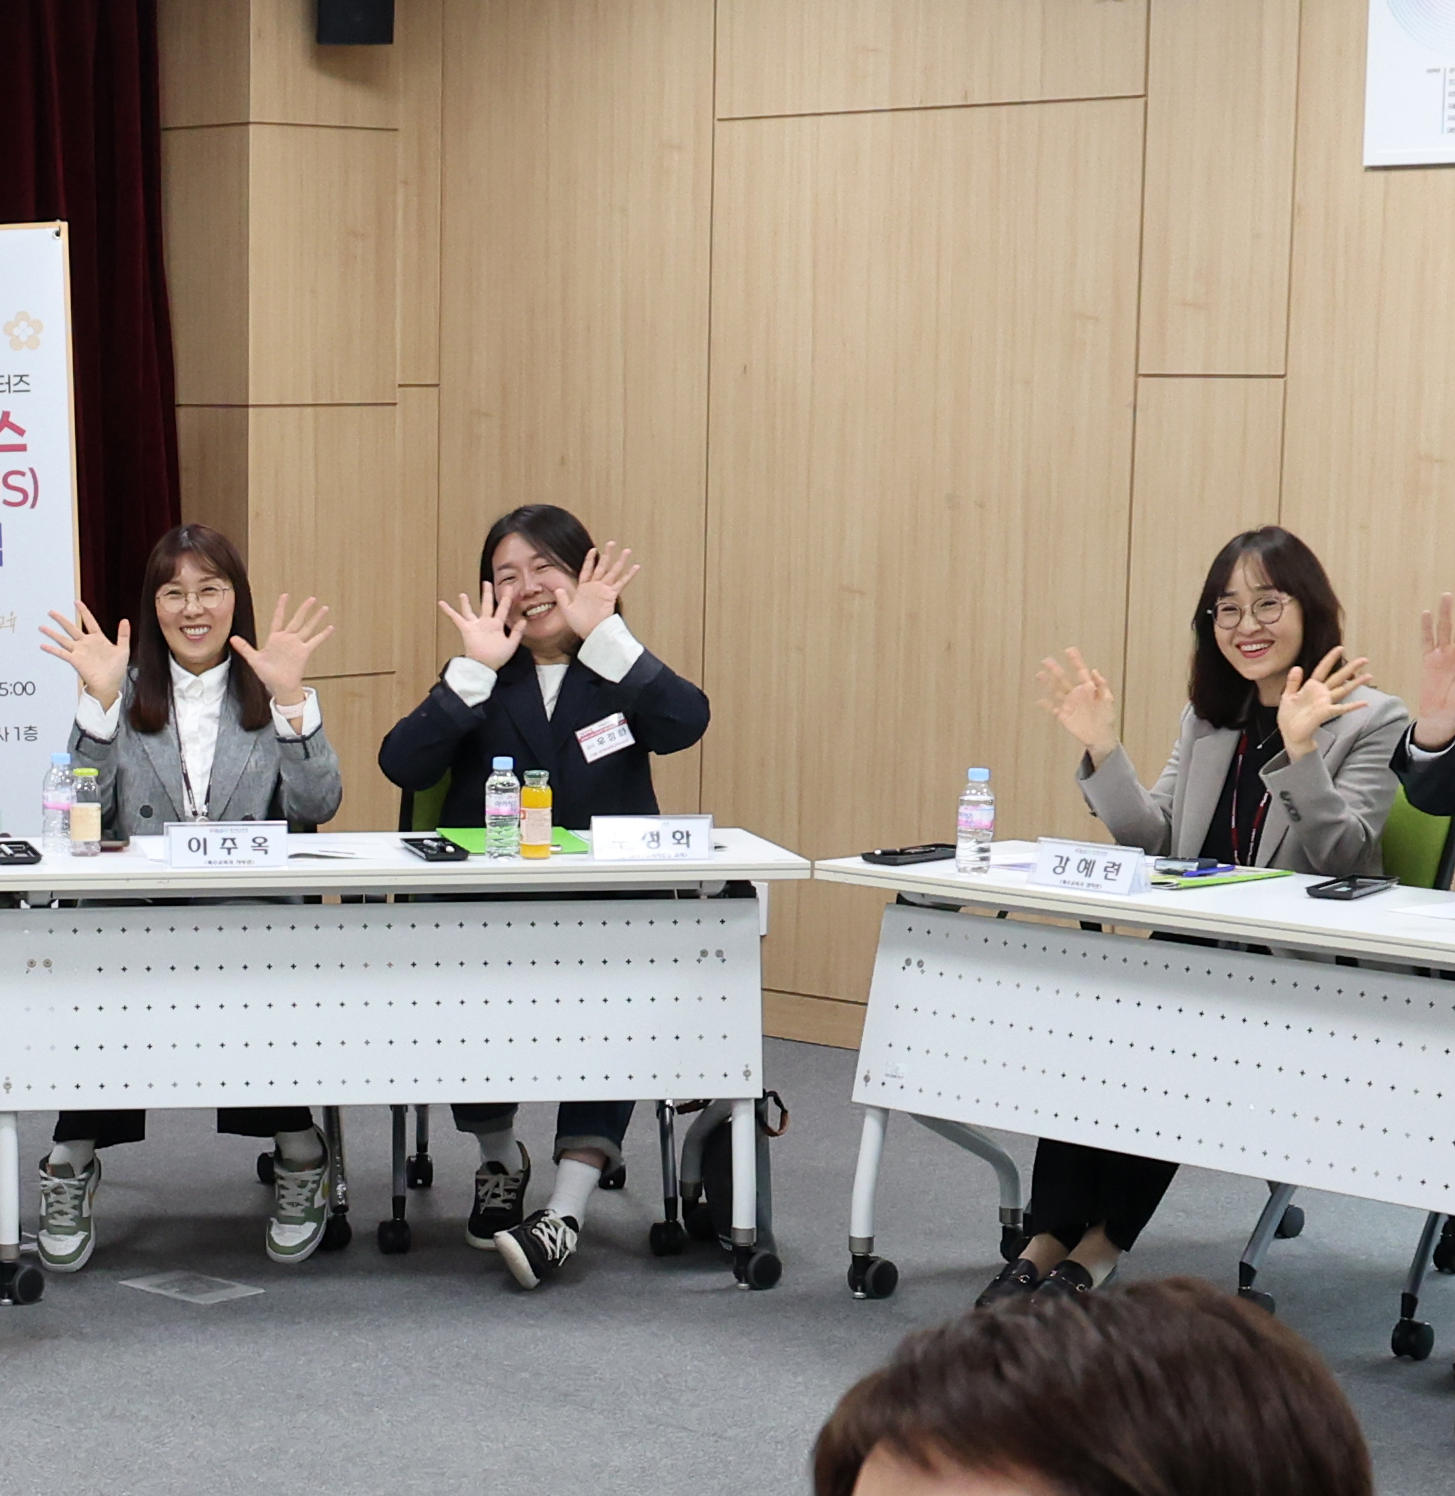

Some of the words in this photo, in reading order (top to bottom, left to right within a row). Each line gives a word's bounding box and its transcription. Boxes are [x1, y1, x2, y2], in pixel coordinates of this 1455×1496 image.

[14, 725, 38, 742] 1층
[187, 836, 270, 856] 이주옥
[1052, 855, 1122, 881] 강예련
